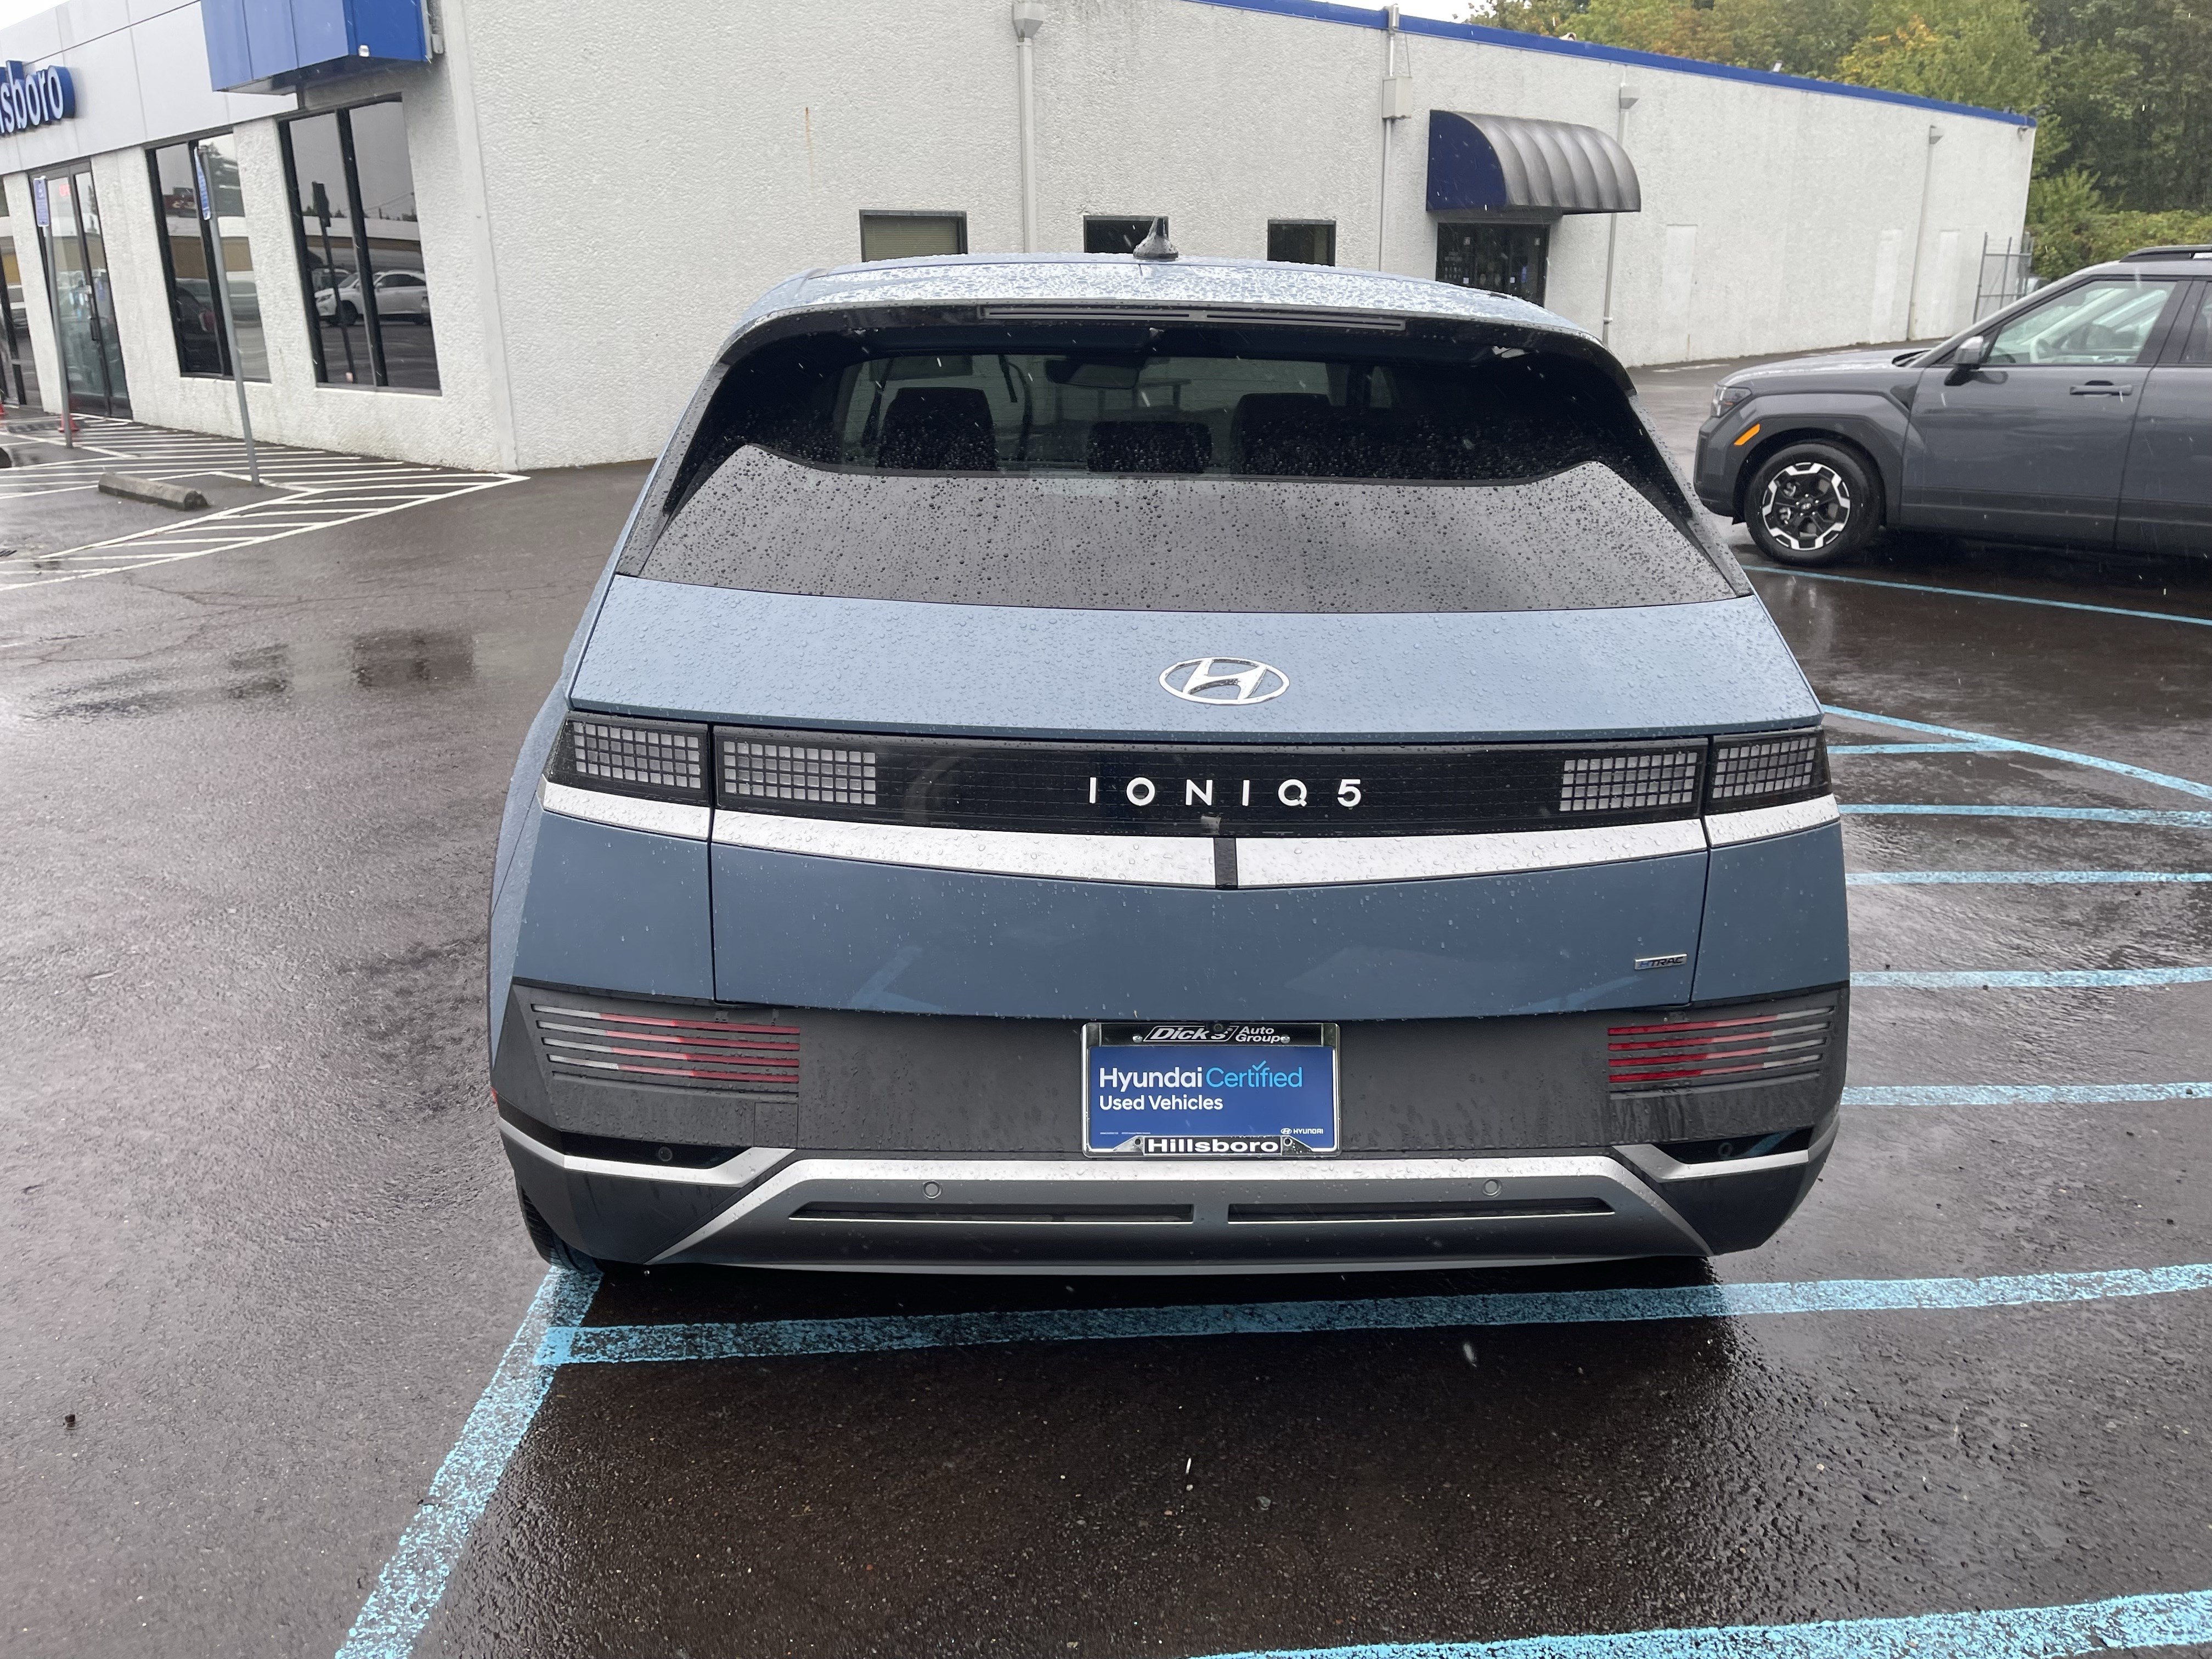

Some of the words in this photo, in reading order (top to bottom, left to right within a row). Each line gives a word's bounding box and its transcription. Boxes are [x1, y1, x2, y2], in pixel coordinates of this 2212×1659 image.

[1089, 777, 1308, 807] IONIQ
[1338, 779, 1362, 807] 5
[1640, 957, 1684, 967] HTRAC
[1239, 1026, 1274, 1035] Auto
[1235, 1034, 1280, 1043] Group
[1099, 1066, 1203, 1092] Hyundai
[1206, 1060, 1303, 1087] Certified
[1099, 1095, 1144, 1110] Used
[1148, 1094, 1223, 1110] Vehicles
[1148, 1139, 1279, 1153] Hillsboro
